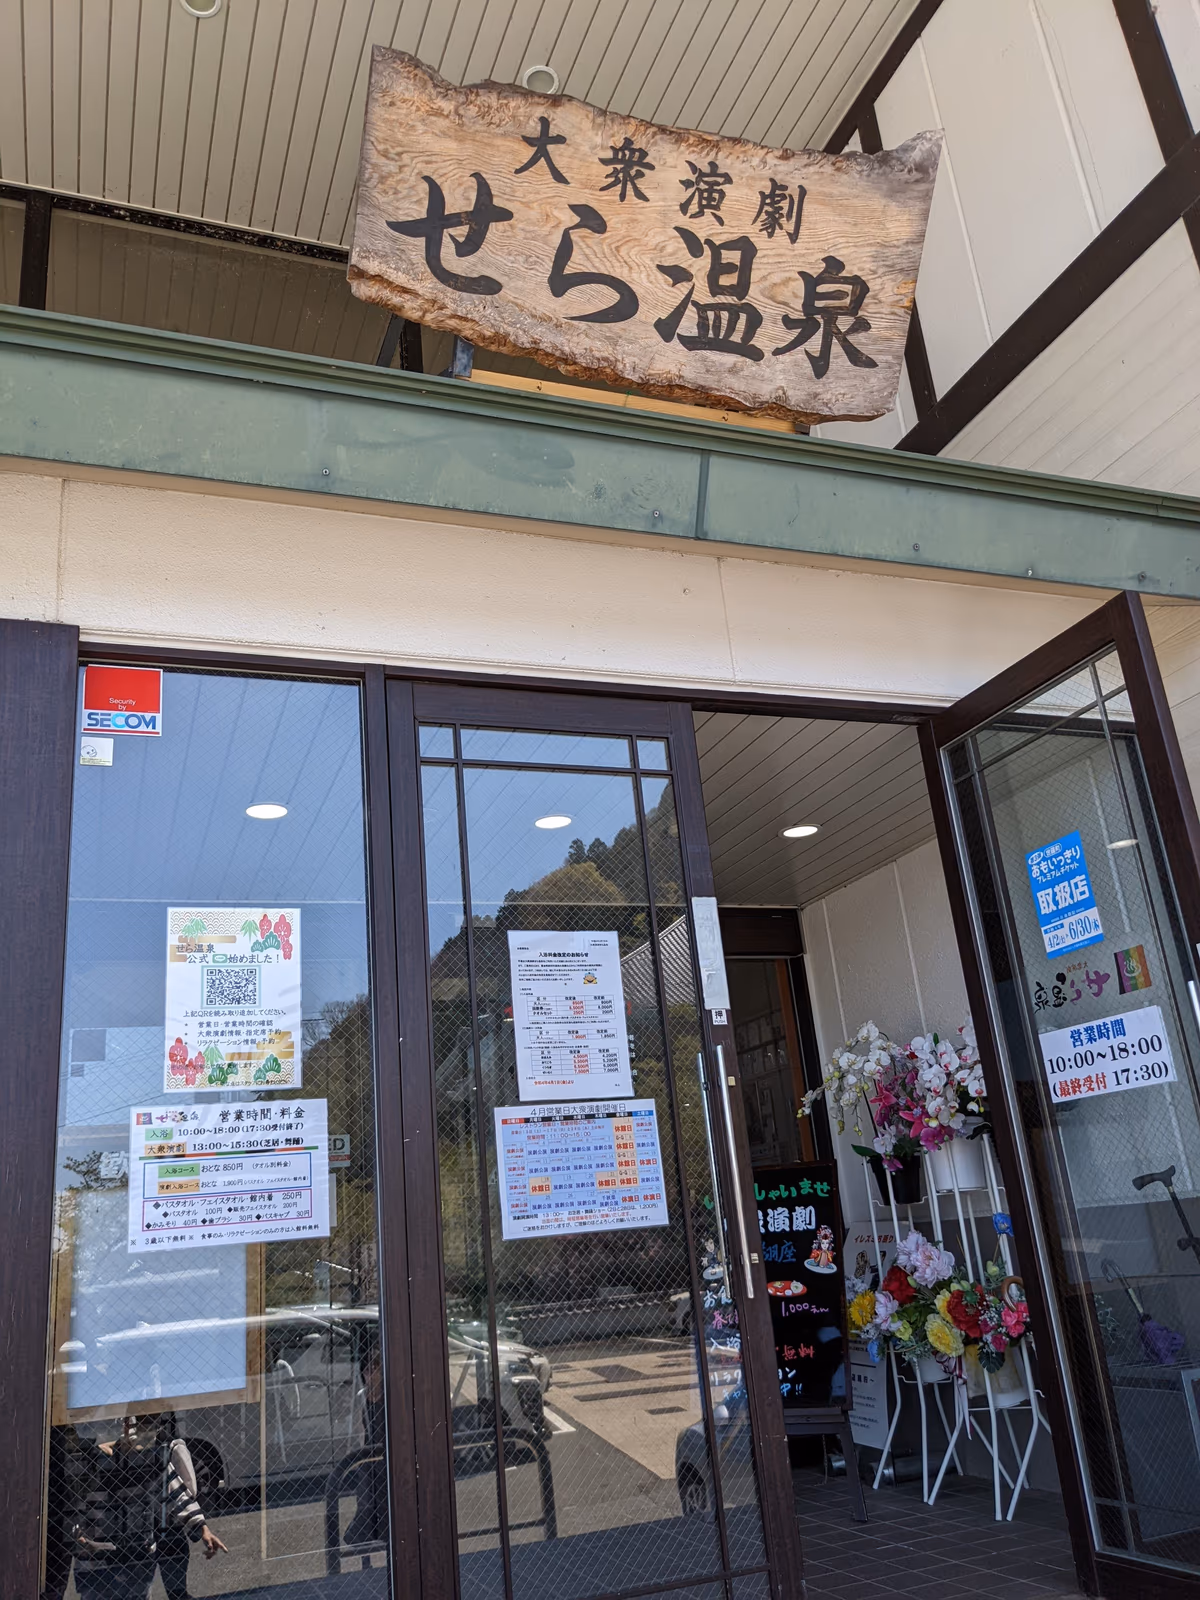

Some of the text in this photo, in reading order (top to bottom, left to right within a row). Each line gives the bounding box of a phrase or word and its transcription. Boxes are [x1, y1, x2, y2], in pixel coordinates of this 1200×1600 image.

[513, 116, 807, 244] 大衆演劇
[386, 172, 879, 379] せら温泉
[109, 698, 136, 707] Security
[87, 712, 157, 730] SECOM
[1031, 845, 1081, 878] おもいっきり
[1037, 862, 1079, 884] プレミアムチケット
[1036, 874, 1090, 915] 取扱店
[175, 943, 216, 953] せら温泉
[187, 954, 280, 964] 公式 始めました!
[183, 1009, 287, 1018] 上記QRを読み取り追加してください。
[714, 1010, 723, 1020] 押
[198, 1020, 273, 1028] 営業日・営業時間の確認
[1069, 1018, 1127, 1049] 営業時間
[1047, 1034, 1163, 1075] 10:00~18:00
[219, 1106, 306, 1123] 営業時間・料金
[150, 1129, 169, 1139] 入浴
[147, 1143, 185, 1155] 大衆演劇
[164, 1166, 195, 1175] 入浴コース
[201, 1164, 221, 1173] おとな
[222, 1162, 244, 1172] 850円
[158, 1182, 200, 1191] 演劇入浴コース
[201, 1180, 218, 1188] おとな
[282, 1191, 302, 1200] 250円
[168, 1209, 198, 1217] バスタオル
[205, 1207, 223, 1216] 100円
[151, 1220, 177, 1228] かみそり
[208, 1216, 233, 1225] 歯ブラシ
[238, 1214, 253, 1222] 30円
[144, 1234, 187, 1245] 3歳以下無料
